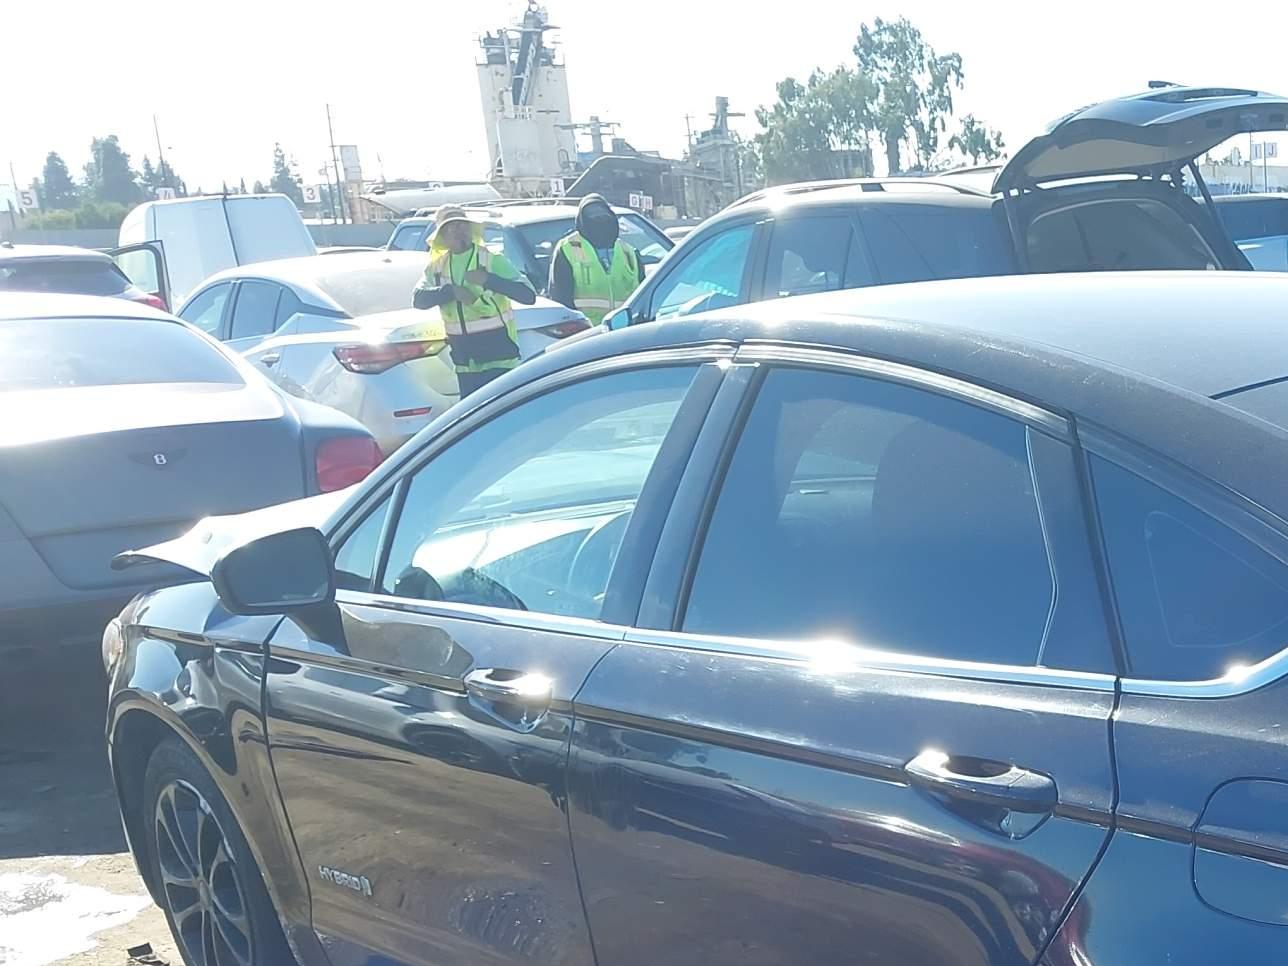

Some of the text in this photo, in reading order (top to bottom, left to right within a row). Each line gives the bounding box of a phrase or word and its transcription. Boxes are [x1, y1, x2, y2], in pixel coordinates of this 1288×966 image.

[554, 181, 562, 192] 1
[21, 191, 33, 206] 5
[306, 187, 316, 201] 3
[318, 865, 361, 891] HYBRID
